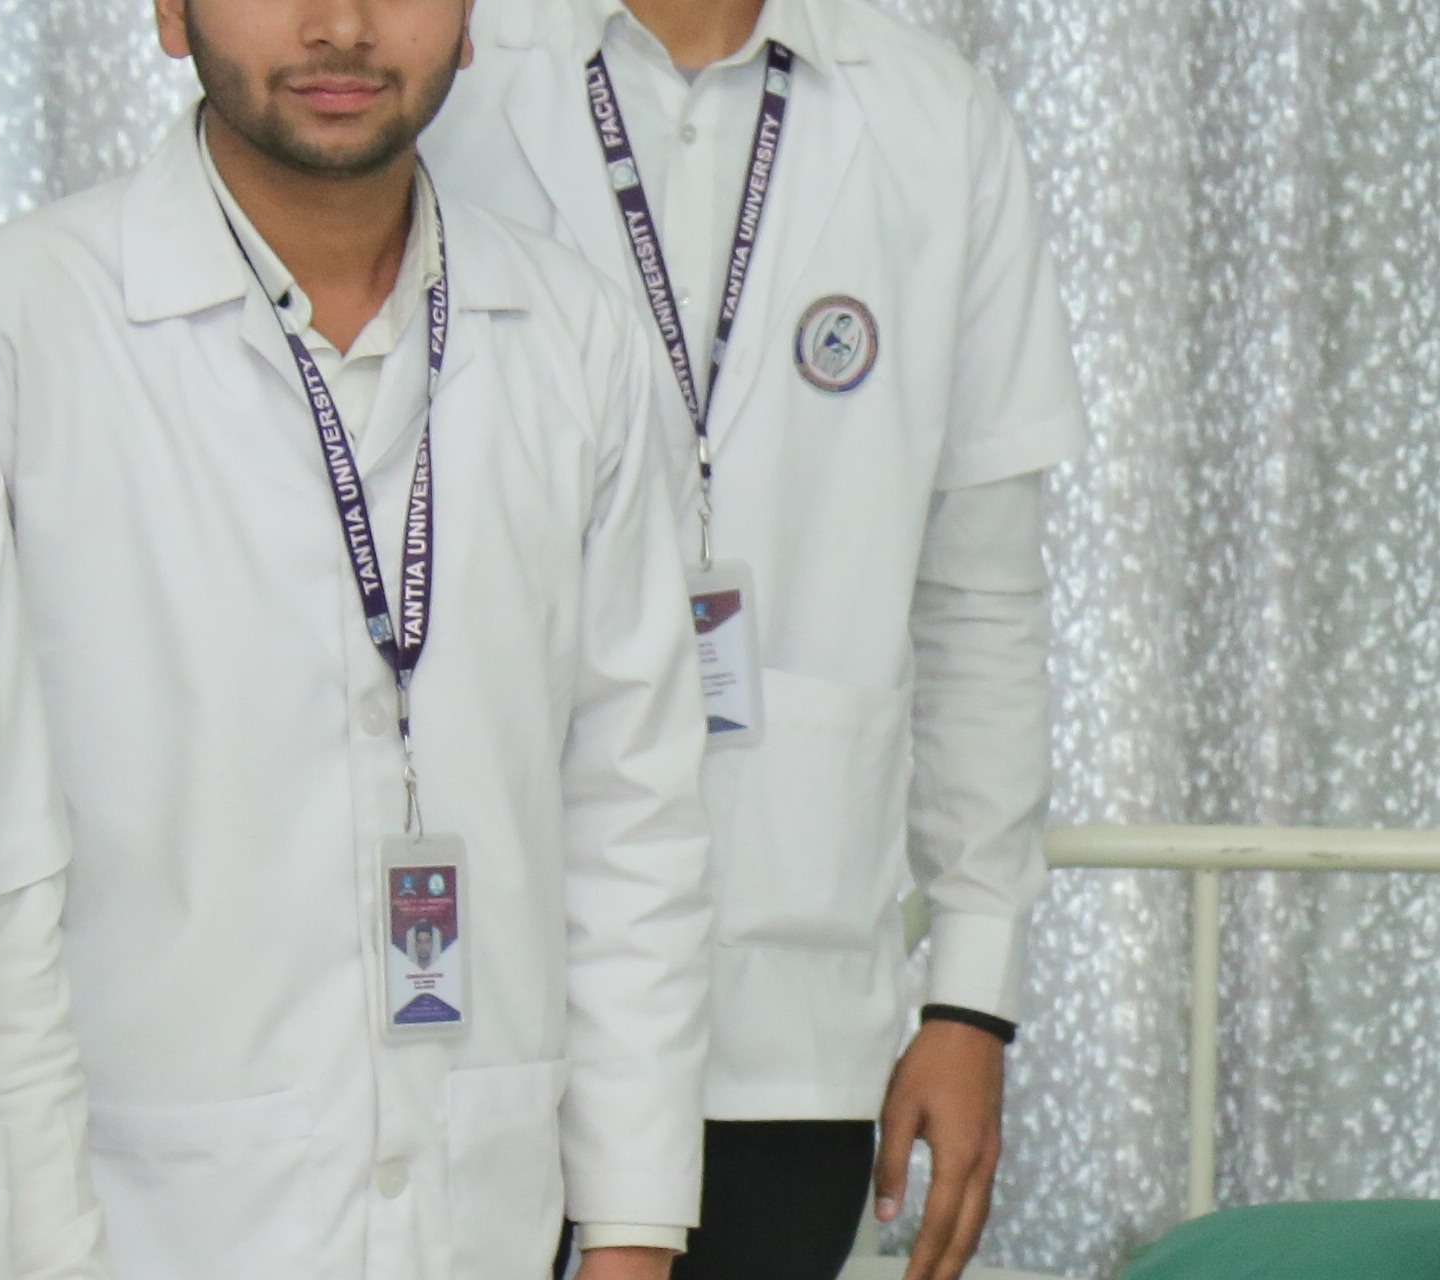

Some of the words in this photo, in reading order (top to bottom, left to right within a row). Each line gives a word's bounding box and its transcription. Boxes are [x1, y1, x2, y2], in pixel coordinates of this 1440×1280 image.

[625, 209, 680, 341] UNIVERSITY
[721, 247, 749, 320] TANTIA
[738, 113, 781, 242] UNIVERSITY
[297, 356, 359, 501] UNIVERSITY
[344, 504, 380, 596] TANTIA
[403, 559, 425, 649] TANTIA
